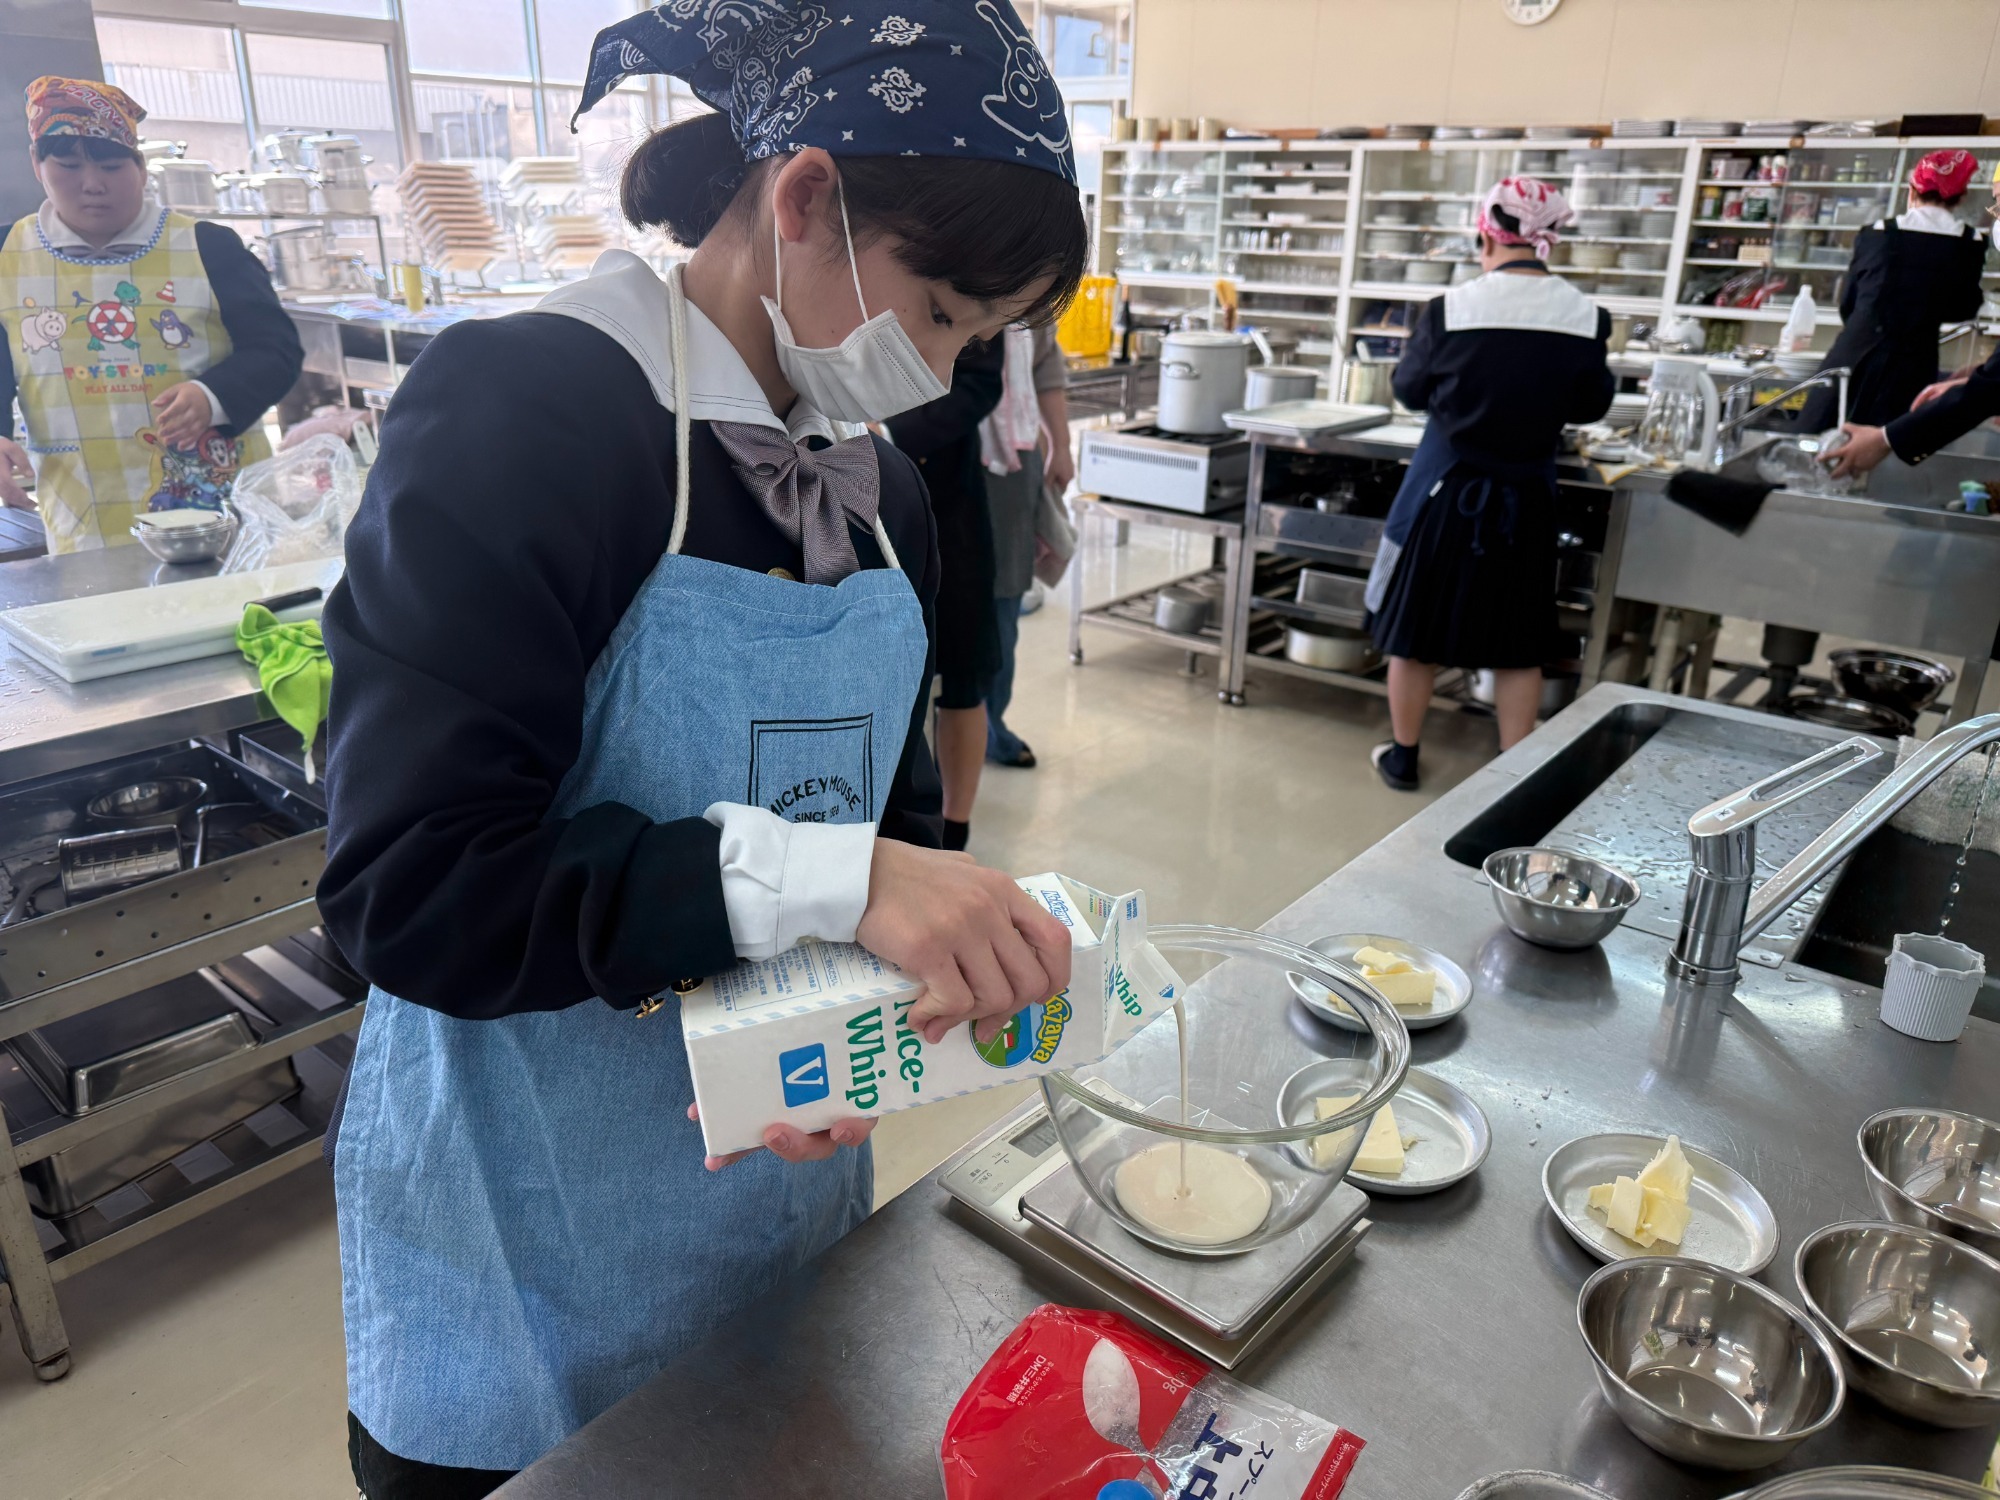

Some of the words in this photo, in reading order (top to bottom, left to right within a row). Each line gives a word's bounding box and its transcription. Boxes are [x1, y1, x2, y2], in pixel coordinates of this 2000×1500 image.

[63, 365, 100, 380] TOY
[105, 363, 168, 379] STORY
[110, 384, 129, 393] ALL
[829, 775, 862, 812] MOUSE
[794, 811, 826, 823] SINCE
[1031, 987, 1072, 1064] kazawa
[845, 1005, 887, 1110] Whip
